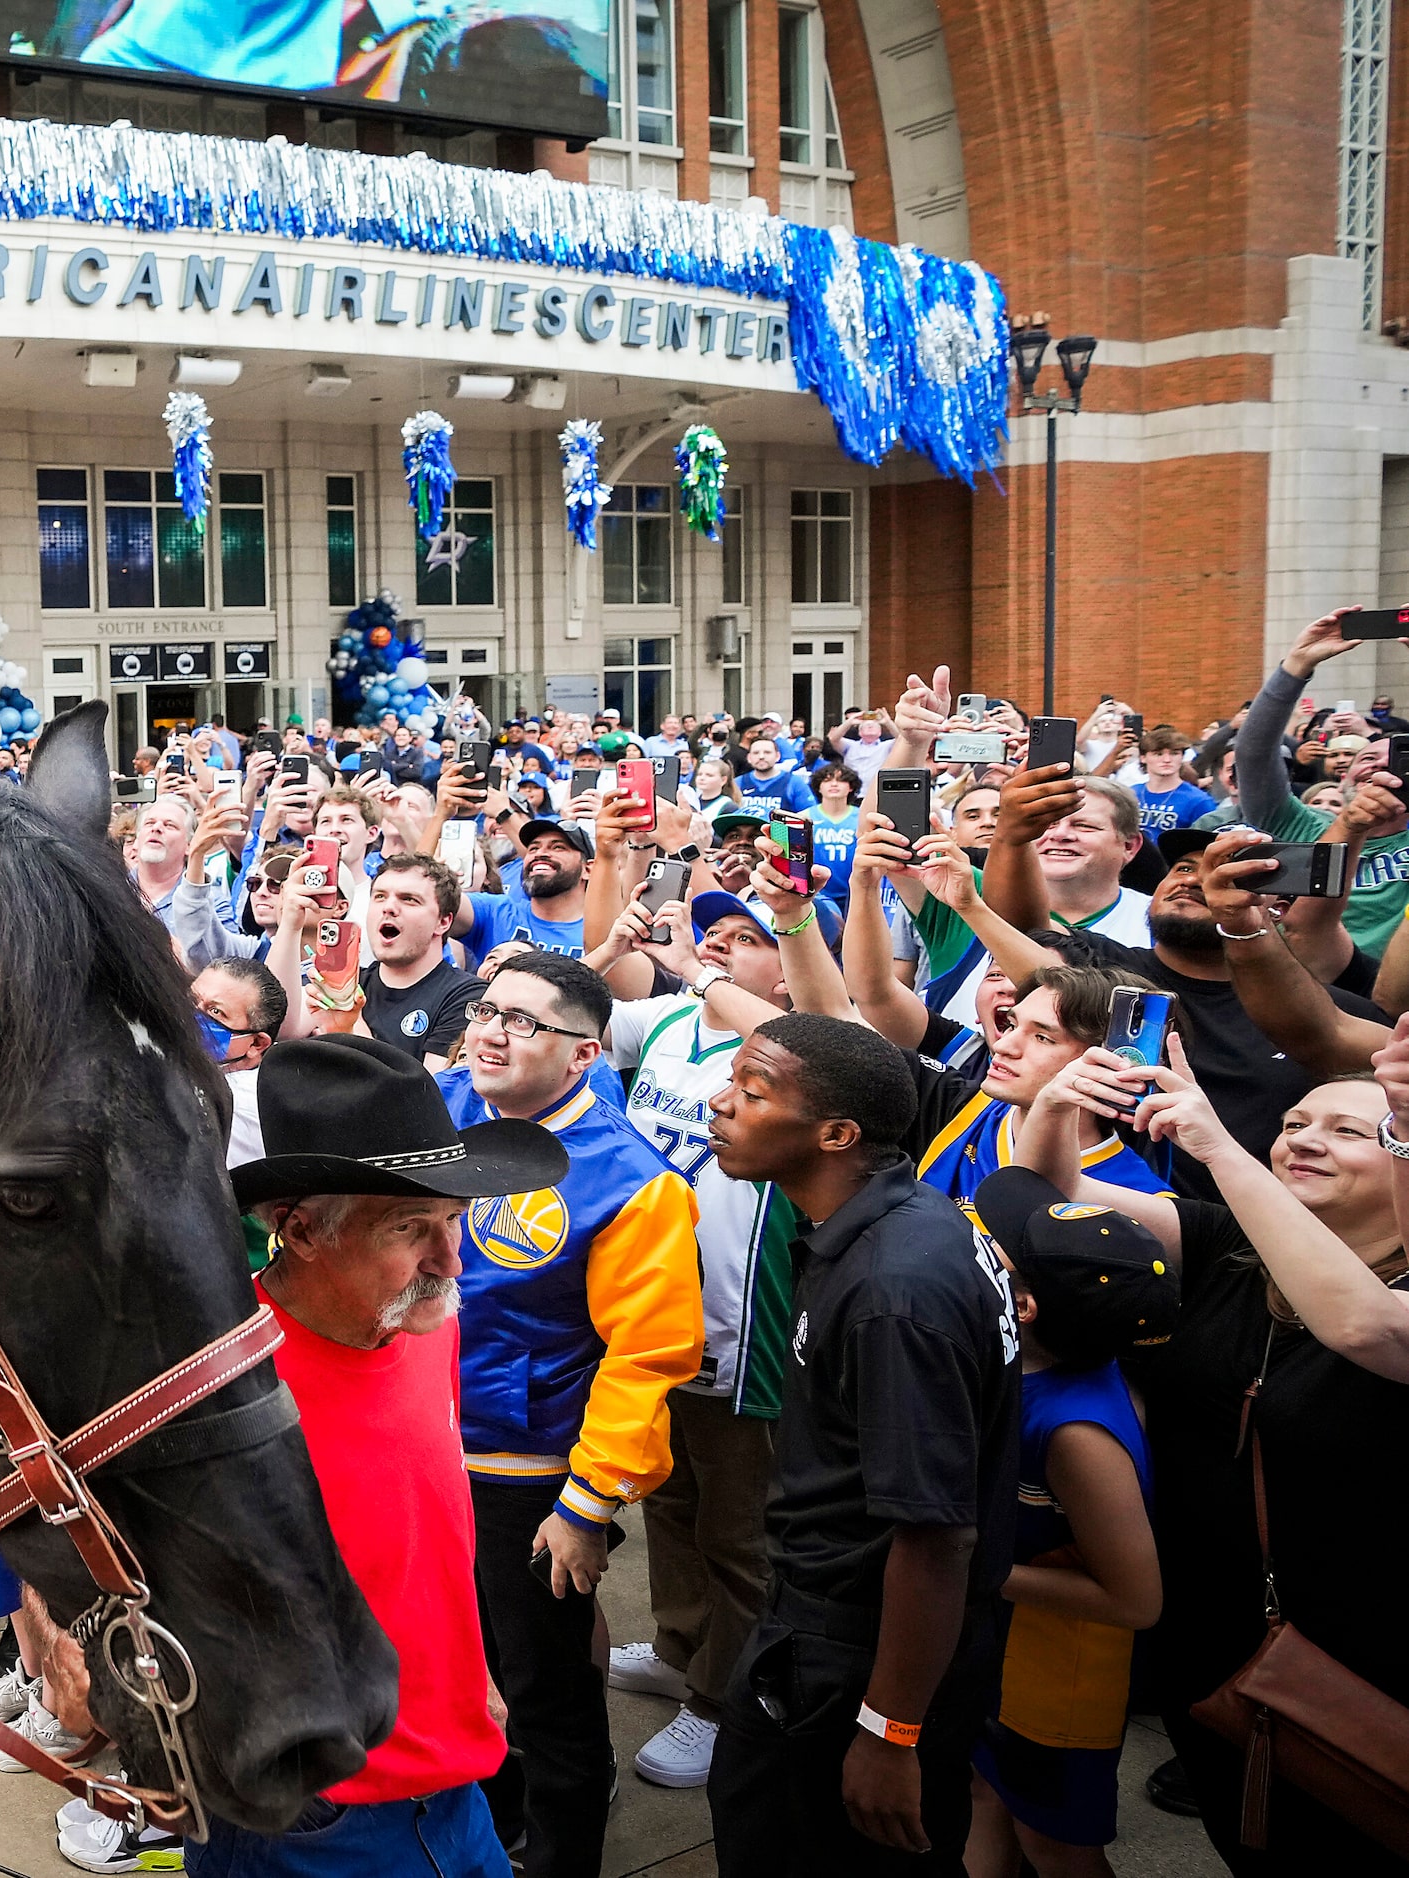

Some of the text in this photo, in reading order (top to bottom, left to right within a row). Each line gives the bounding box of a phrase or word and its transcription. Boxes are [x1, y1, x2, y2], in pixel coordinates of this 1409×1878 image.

[97, 620, 225, 635] SOUTH ENTRANCE
[824, 844, 847, 862] 77
[633, 1081, 716, 1124] DALLA
